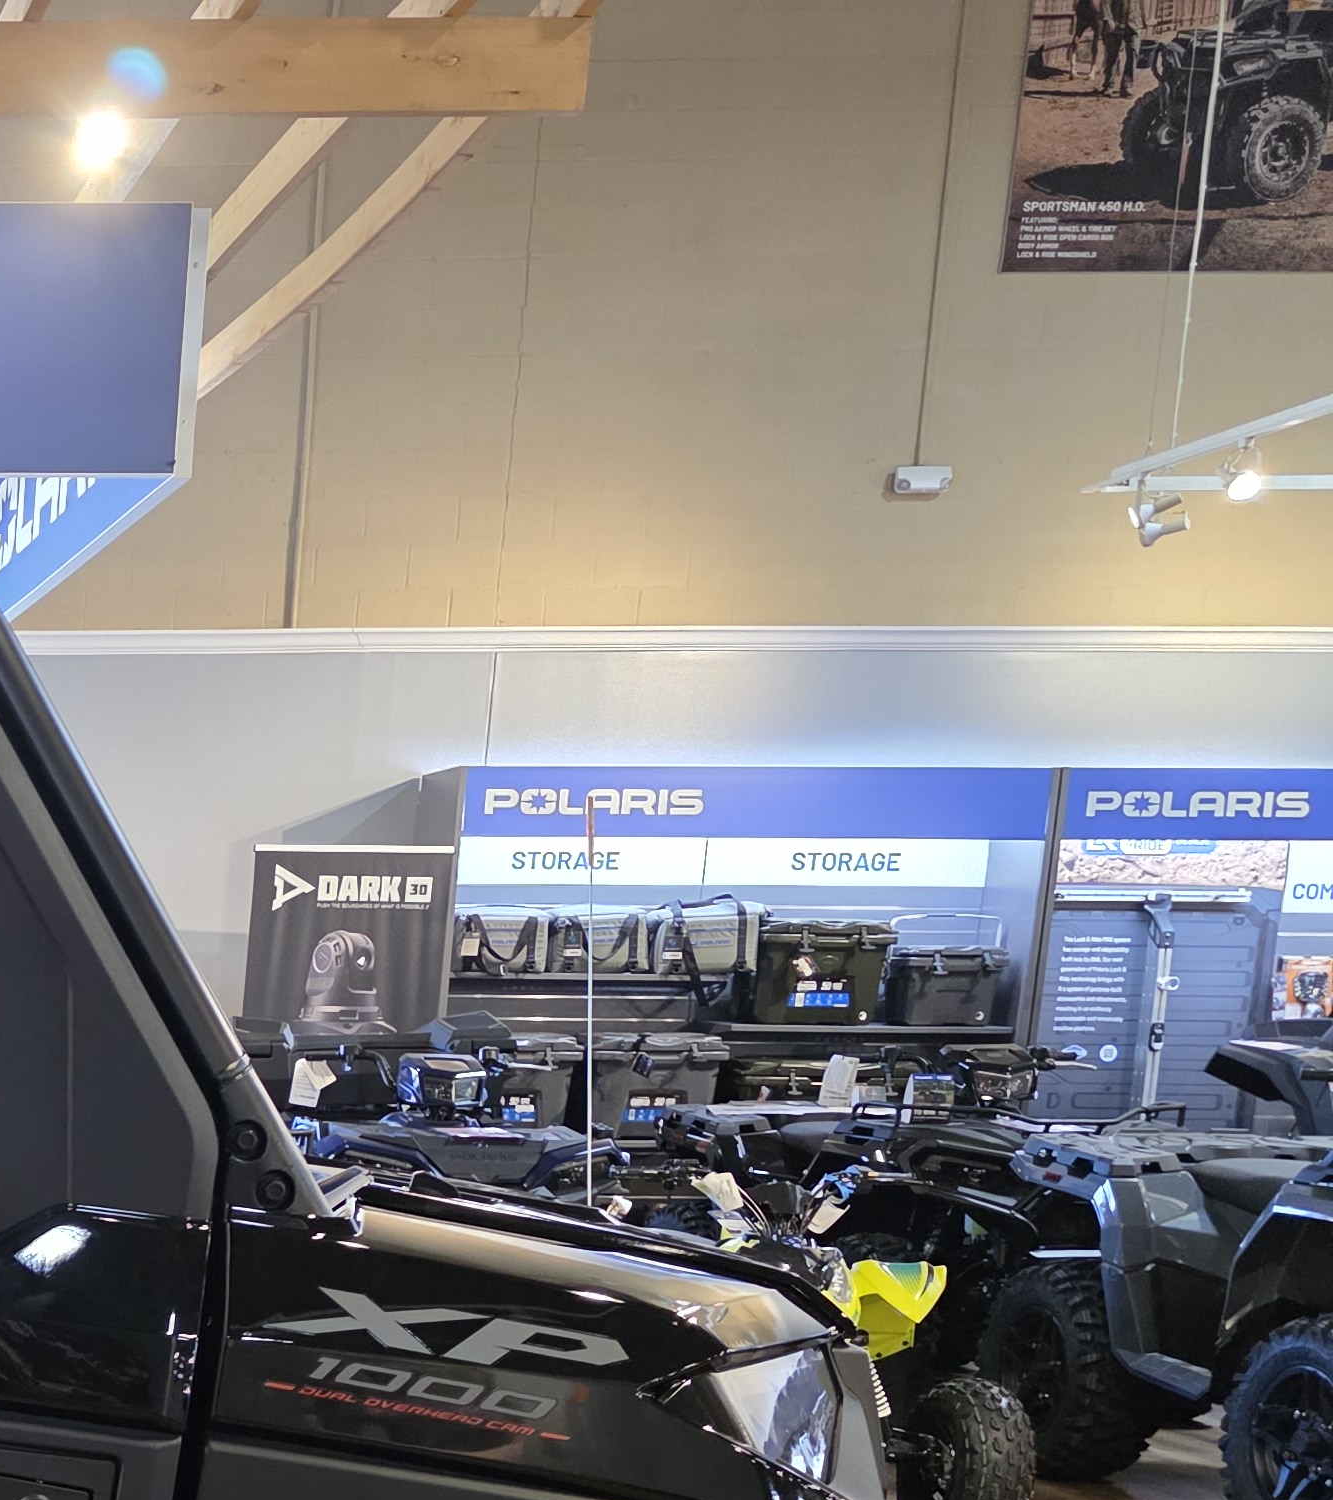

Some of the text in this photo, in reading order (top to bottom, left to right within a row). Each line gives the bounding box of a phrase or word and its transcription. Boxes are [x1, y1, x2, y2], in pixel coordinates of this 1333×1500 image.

[1023, 201, 1146, 212] SPORTSMAN 450 H.O.
[484, 787, 704, 816] POLARIS
[1085, 790, 1310, 818] POLARIS
[511, 851, 620, 872] STORAGE
[791, 852, 901, 873] STORAGE
[317, 874, 429, 902] DARK 30
[1293, 883, 1333, 900] COM
[263, 1286, 630, 1366] XP
[308, 1356, 558, 1420] 1000
[298, 1384, 536, 1437] DUAL OVERHEAD CAM
